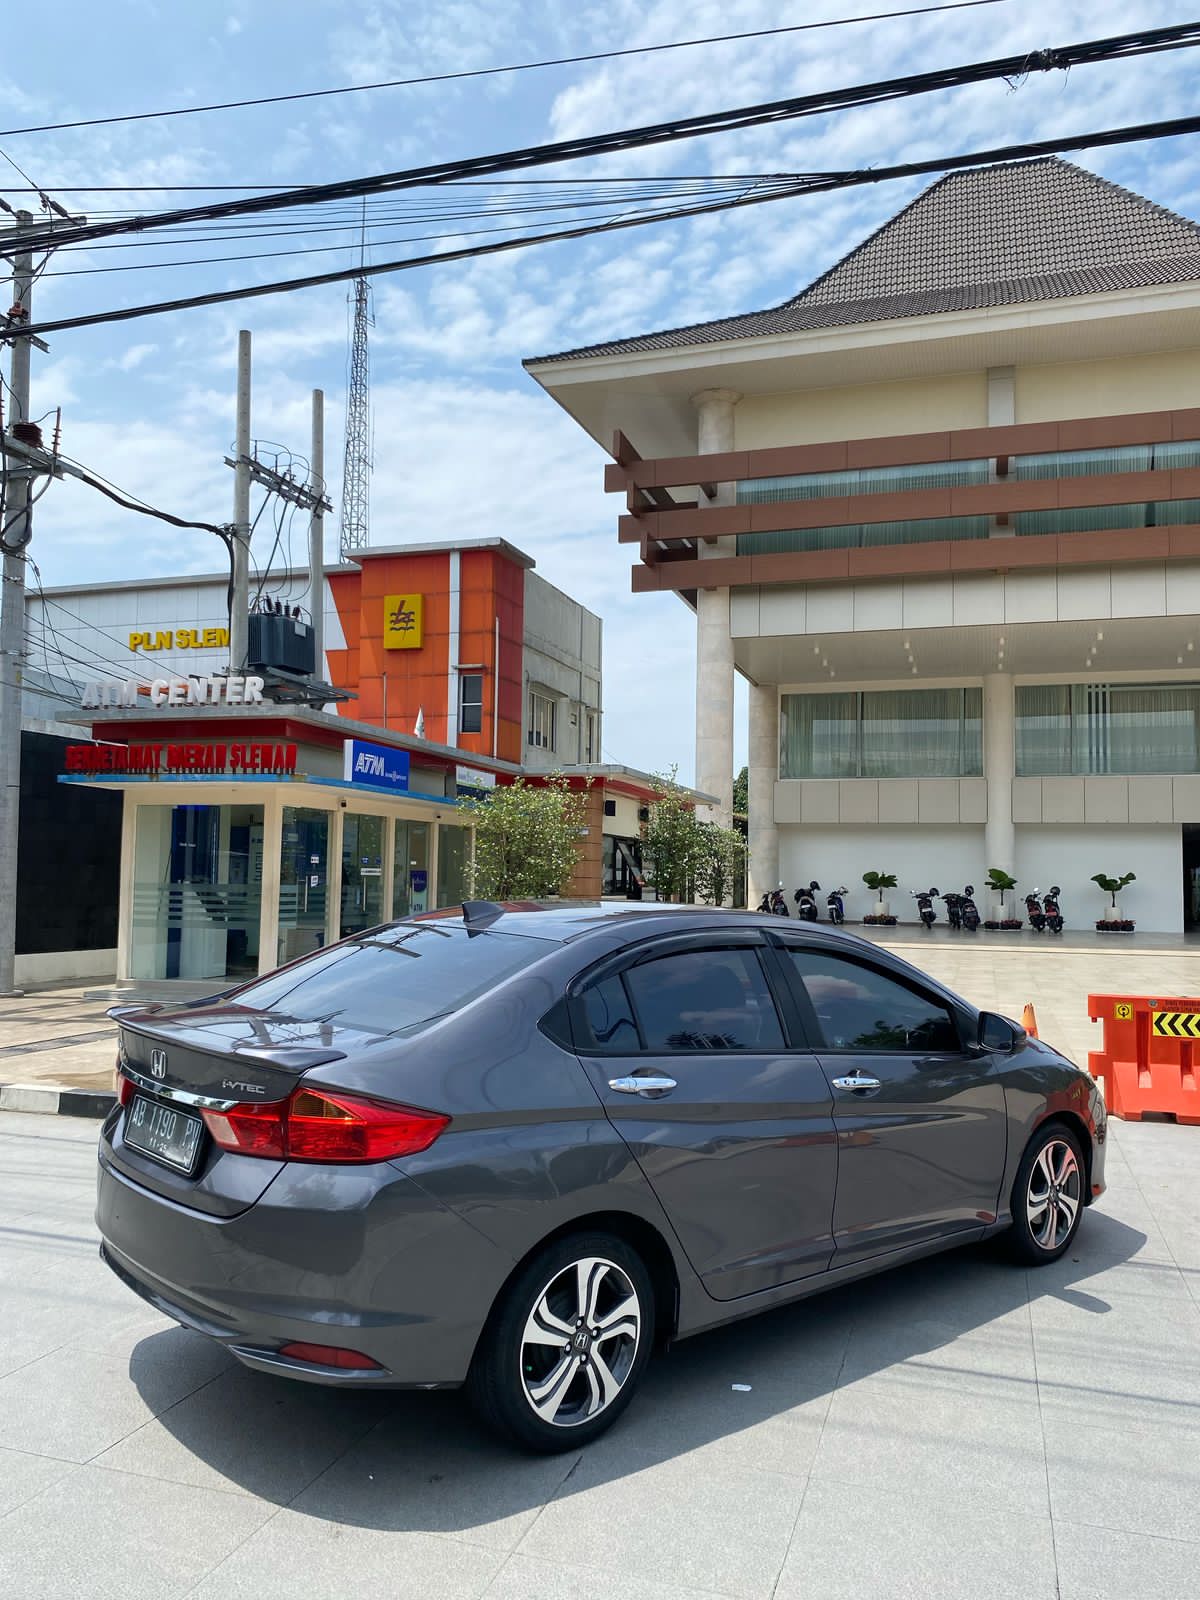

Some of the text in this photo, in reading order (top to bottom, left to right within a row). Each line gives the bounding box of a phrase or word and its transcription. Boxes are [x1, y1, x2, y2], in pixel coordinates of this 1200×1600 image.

[129, 631, 172, 651] PLN
[82, 676, 265, 706] ATM CENTER
[355, 752, 385, 777] ATM
[132, 1099, 147, 1127] AB
[149, 1106, 177, 1140] 1190
